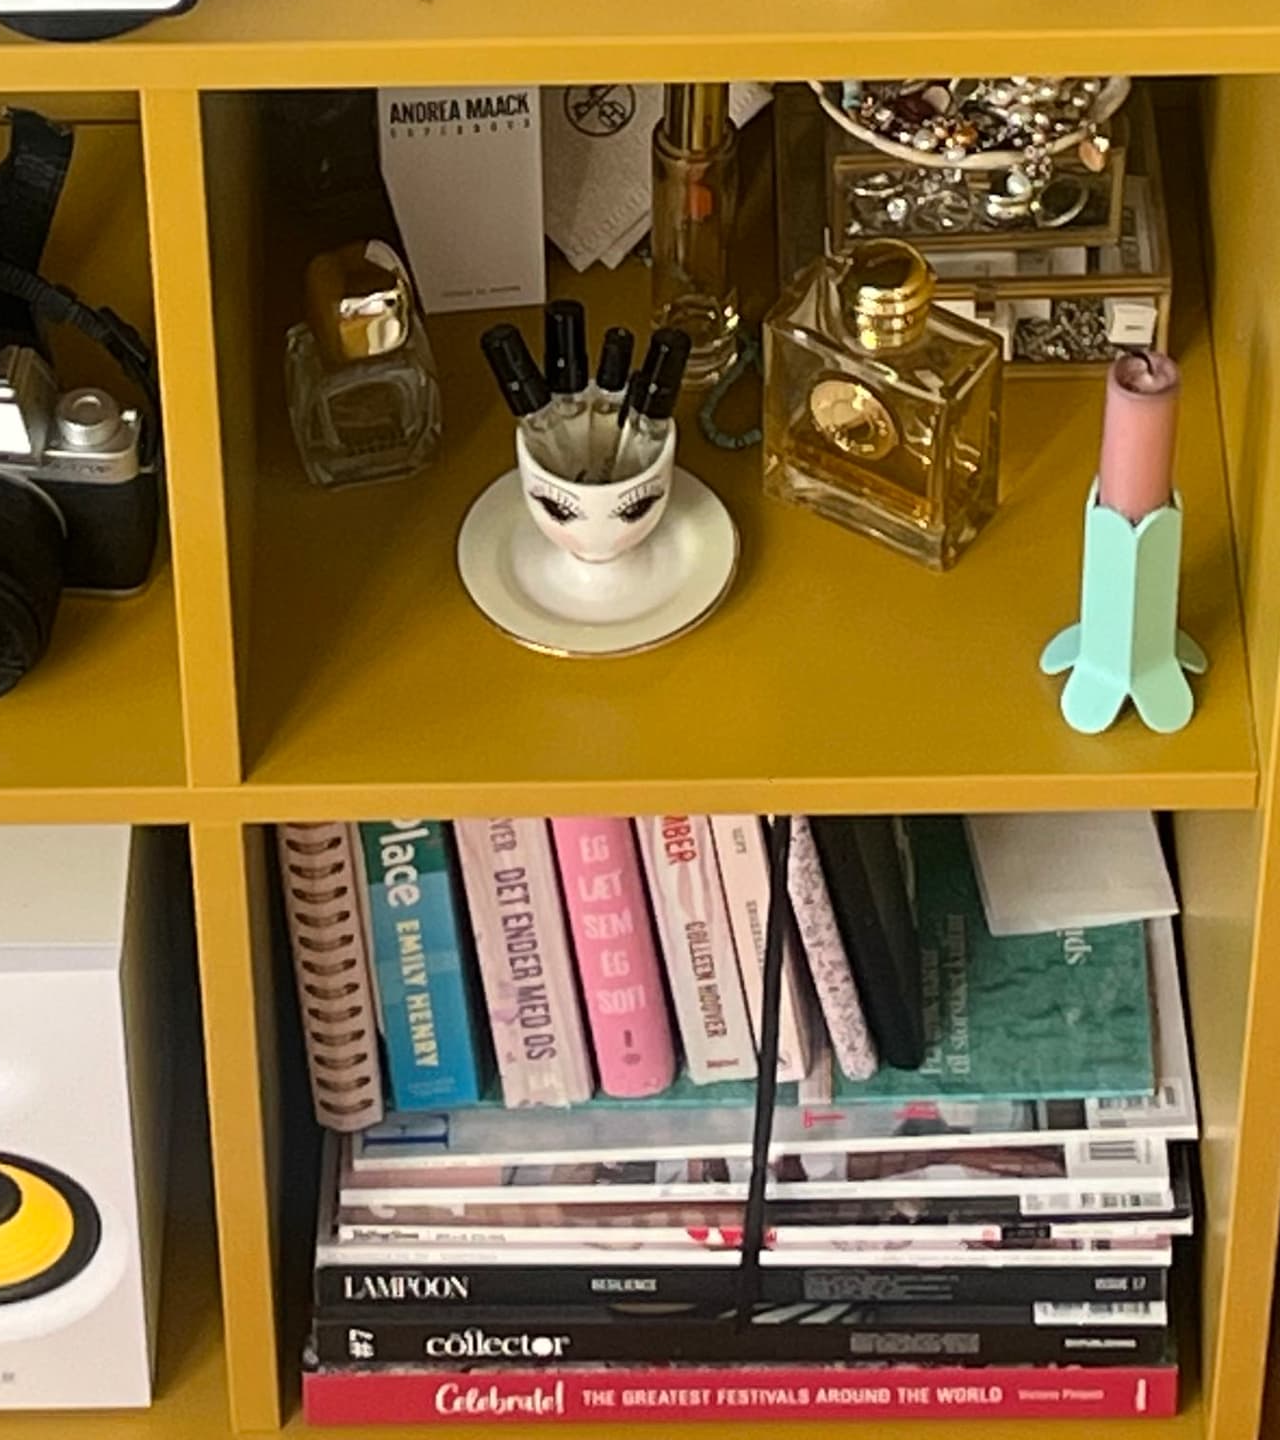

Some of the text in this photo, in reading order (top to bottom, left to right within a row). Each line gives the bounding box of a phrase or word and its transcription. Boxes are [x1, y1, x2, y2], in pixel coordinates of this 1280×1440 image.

[390, 92, 530, 124] ANDREA MAACK
[494, 866, 530, 905] DET
[396, 919, 428, 986] EMILY
[501, 912, 543, 980] ENDER
[518, 983, 552, 1028] MED
[406, 993, 439, 1066] HENRY
[523, 1034, 557, 1061] OS
[344, 1275, 469, 1299] LAMPOON
[435, 1379, 564, 1414] Celebrate!
[583, 1389, 615, 1407] THE
[621, 1388, 710, 1407] GREATEST
[716, 1387, 810, 1406] FESTIVALS
[816, 1387, 891, 1405] AROUND
[897, 1387, 930, 1404] THE
[936, 1386, 1003, 1404] WORLD
